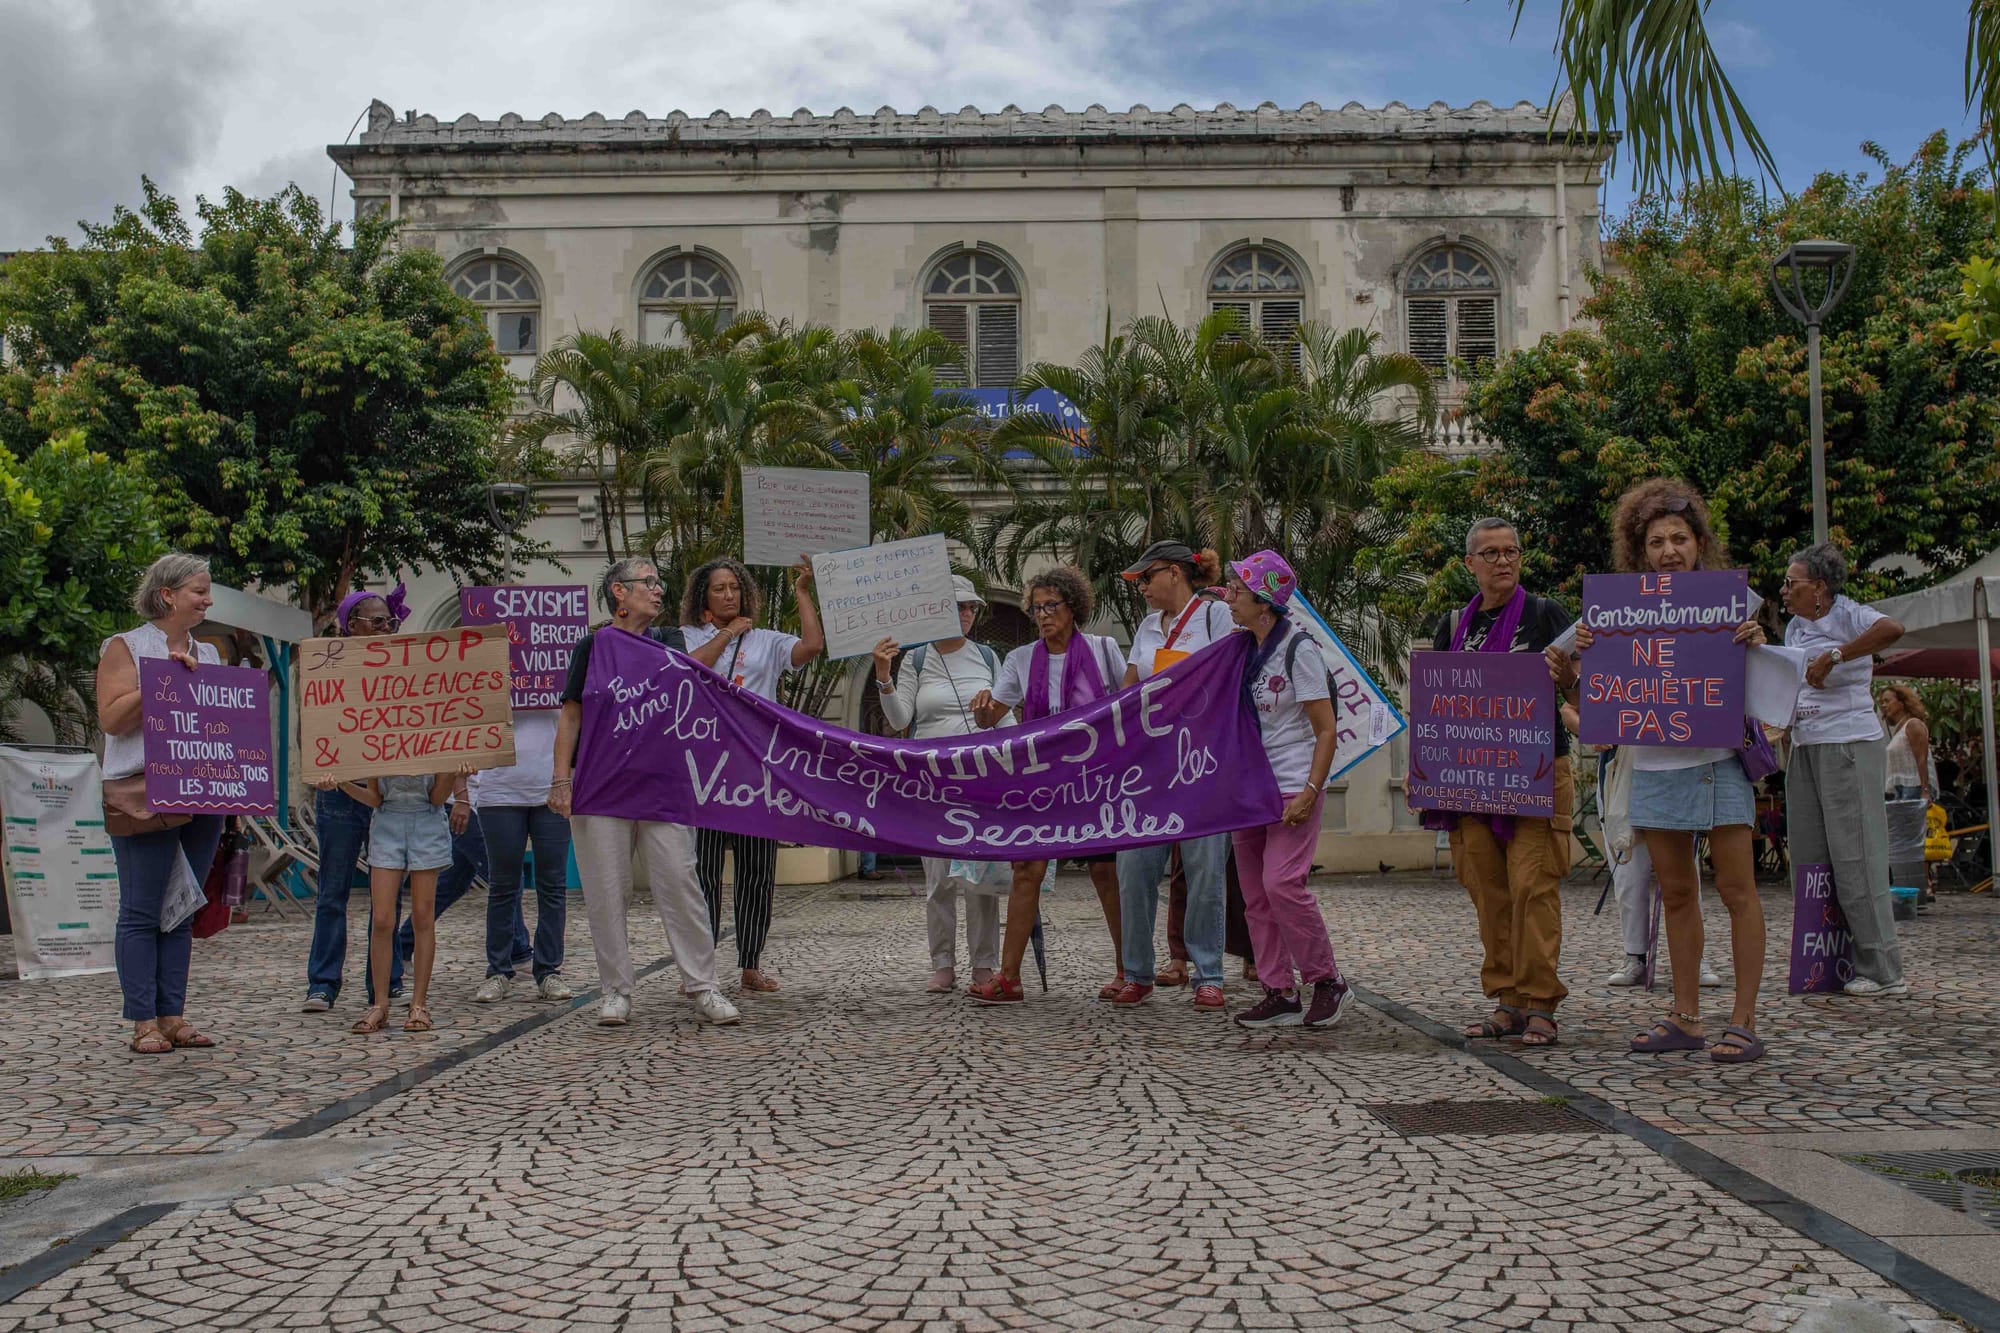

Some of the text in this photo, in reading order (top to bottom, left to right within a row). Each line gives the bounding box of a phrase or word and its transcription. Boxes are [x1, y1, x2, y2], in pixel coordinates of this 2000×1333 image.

[846, 545, 936, 570] LES ENFANTS
[856, 564, 920, 586] PARLENT
[1640, 574, 1672, 595] LE
[494, 589, 586, 618] SEXISME
[828, 588, 902, 610] APPRENONS
[1587, 595, 1746, 628] Consentement
[834, 599, 952, 634] LES ECOUTER
[363, 630, 483, 667] STOP
[1632, 638, 1676, 668] NE
[156, 676, 181, 704] La
[304, 670, 503, 707] AUX VIOLENCES
[534, 675, 555, 690] LE
[1423, 668, 1482, 688] UN PLAN
[1587, 671, 1724, 706] S'ACHÈTE
[510, 690, 563, 708] LISON
[613, 692, 672, 733] une
[1430, 694, 1536, 721] AMBICIEUX
[148, 710, 230, 742] ne TUE pas
[338, 696, 484, 733] SEXISTES
[1618, 710, 1692, 743] PAS
[314, 725, 502, 767] & SEXUELLES
[664, 679, 720, 742] loi
[996, 762, 1152, 812] contre
[1168, 727, 1218, 789] les
[1417, 722, 1551, 745] DES POUVOIRS PUBLICS
[238, 749, 266, 760] mais
[1421, 745, 1521, 768] POUR LUTTER
[150, 762, 184, 776] nous
[240, 765, 268, 782] TOUS
[1440, 768, 1530, 788] CONTRE LES
[180, 779, 247, 798] LES JOURS
[685, 749, 1185, 846] Violences Sexuelles
[1411, 786, 1478, 800] VIOLENCES
[1438, 800, 1518, 814] DES FEMMES
[1805, 872, 1831, 899] PIES
